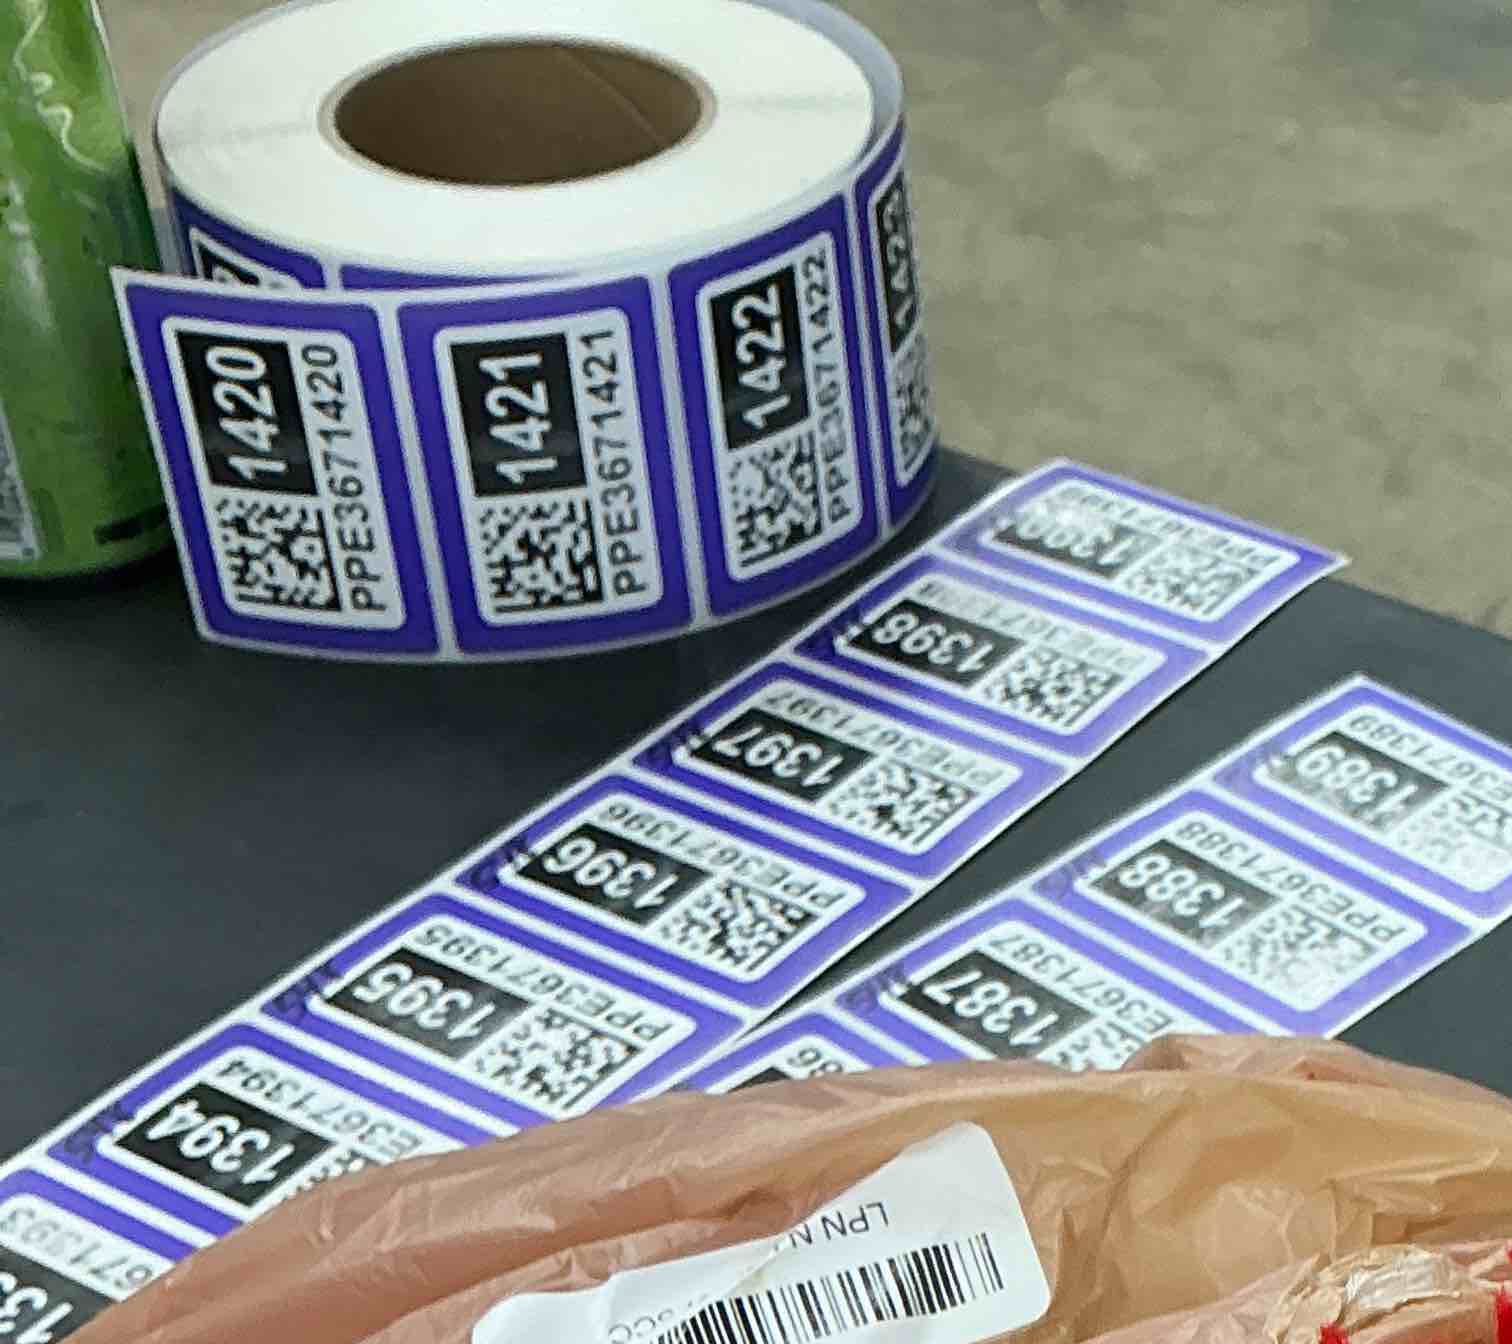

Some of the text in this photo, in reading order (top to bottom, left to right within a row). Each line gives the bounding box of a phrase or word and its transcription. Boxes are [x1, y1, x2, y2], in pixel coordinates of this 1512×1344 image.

[731, 283, 792, 430] 1422
[802, 248, 851, 524] PPE3671422
[206, 345, 289, 480] 1420
[482, 351, 557, 483] 1421
[577, 329, 648, 594] PPE3671421
[302, 343, 387, 612] PPE3671420
[876, 611, 995, 675] 1398
[711, 725, 845, 787] 1397
[1294, 744, 1420, 816] 1389
[543, 836, 681, 908] 1396
[607, 802, 850, 910] PPE3671396
[1118, 853, 1245, 930] 1388
[1175, 819, 1407, 945] PPE3671388
[352, 961, 496, 1040] 1395
[422, 923, 674, 1041] PPE3671395
[921, 969, 1063, 1048] 1387
[988, 932, 1174, 1035] E3671387
[146, 1098, 296, 1186] 1394
[218, 1058, 424, 1156] E3671394
[822, 1201, 890, 1243] LPN
